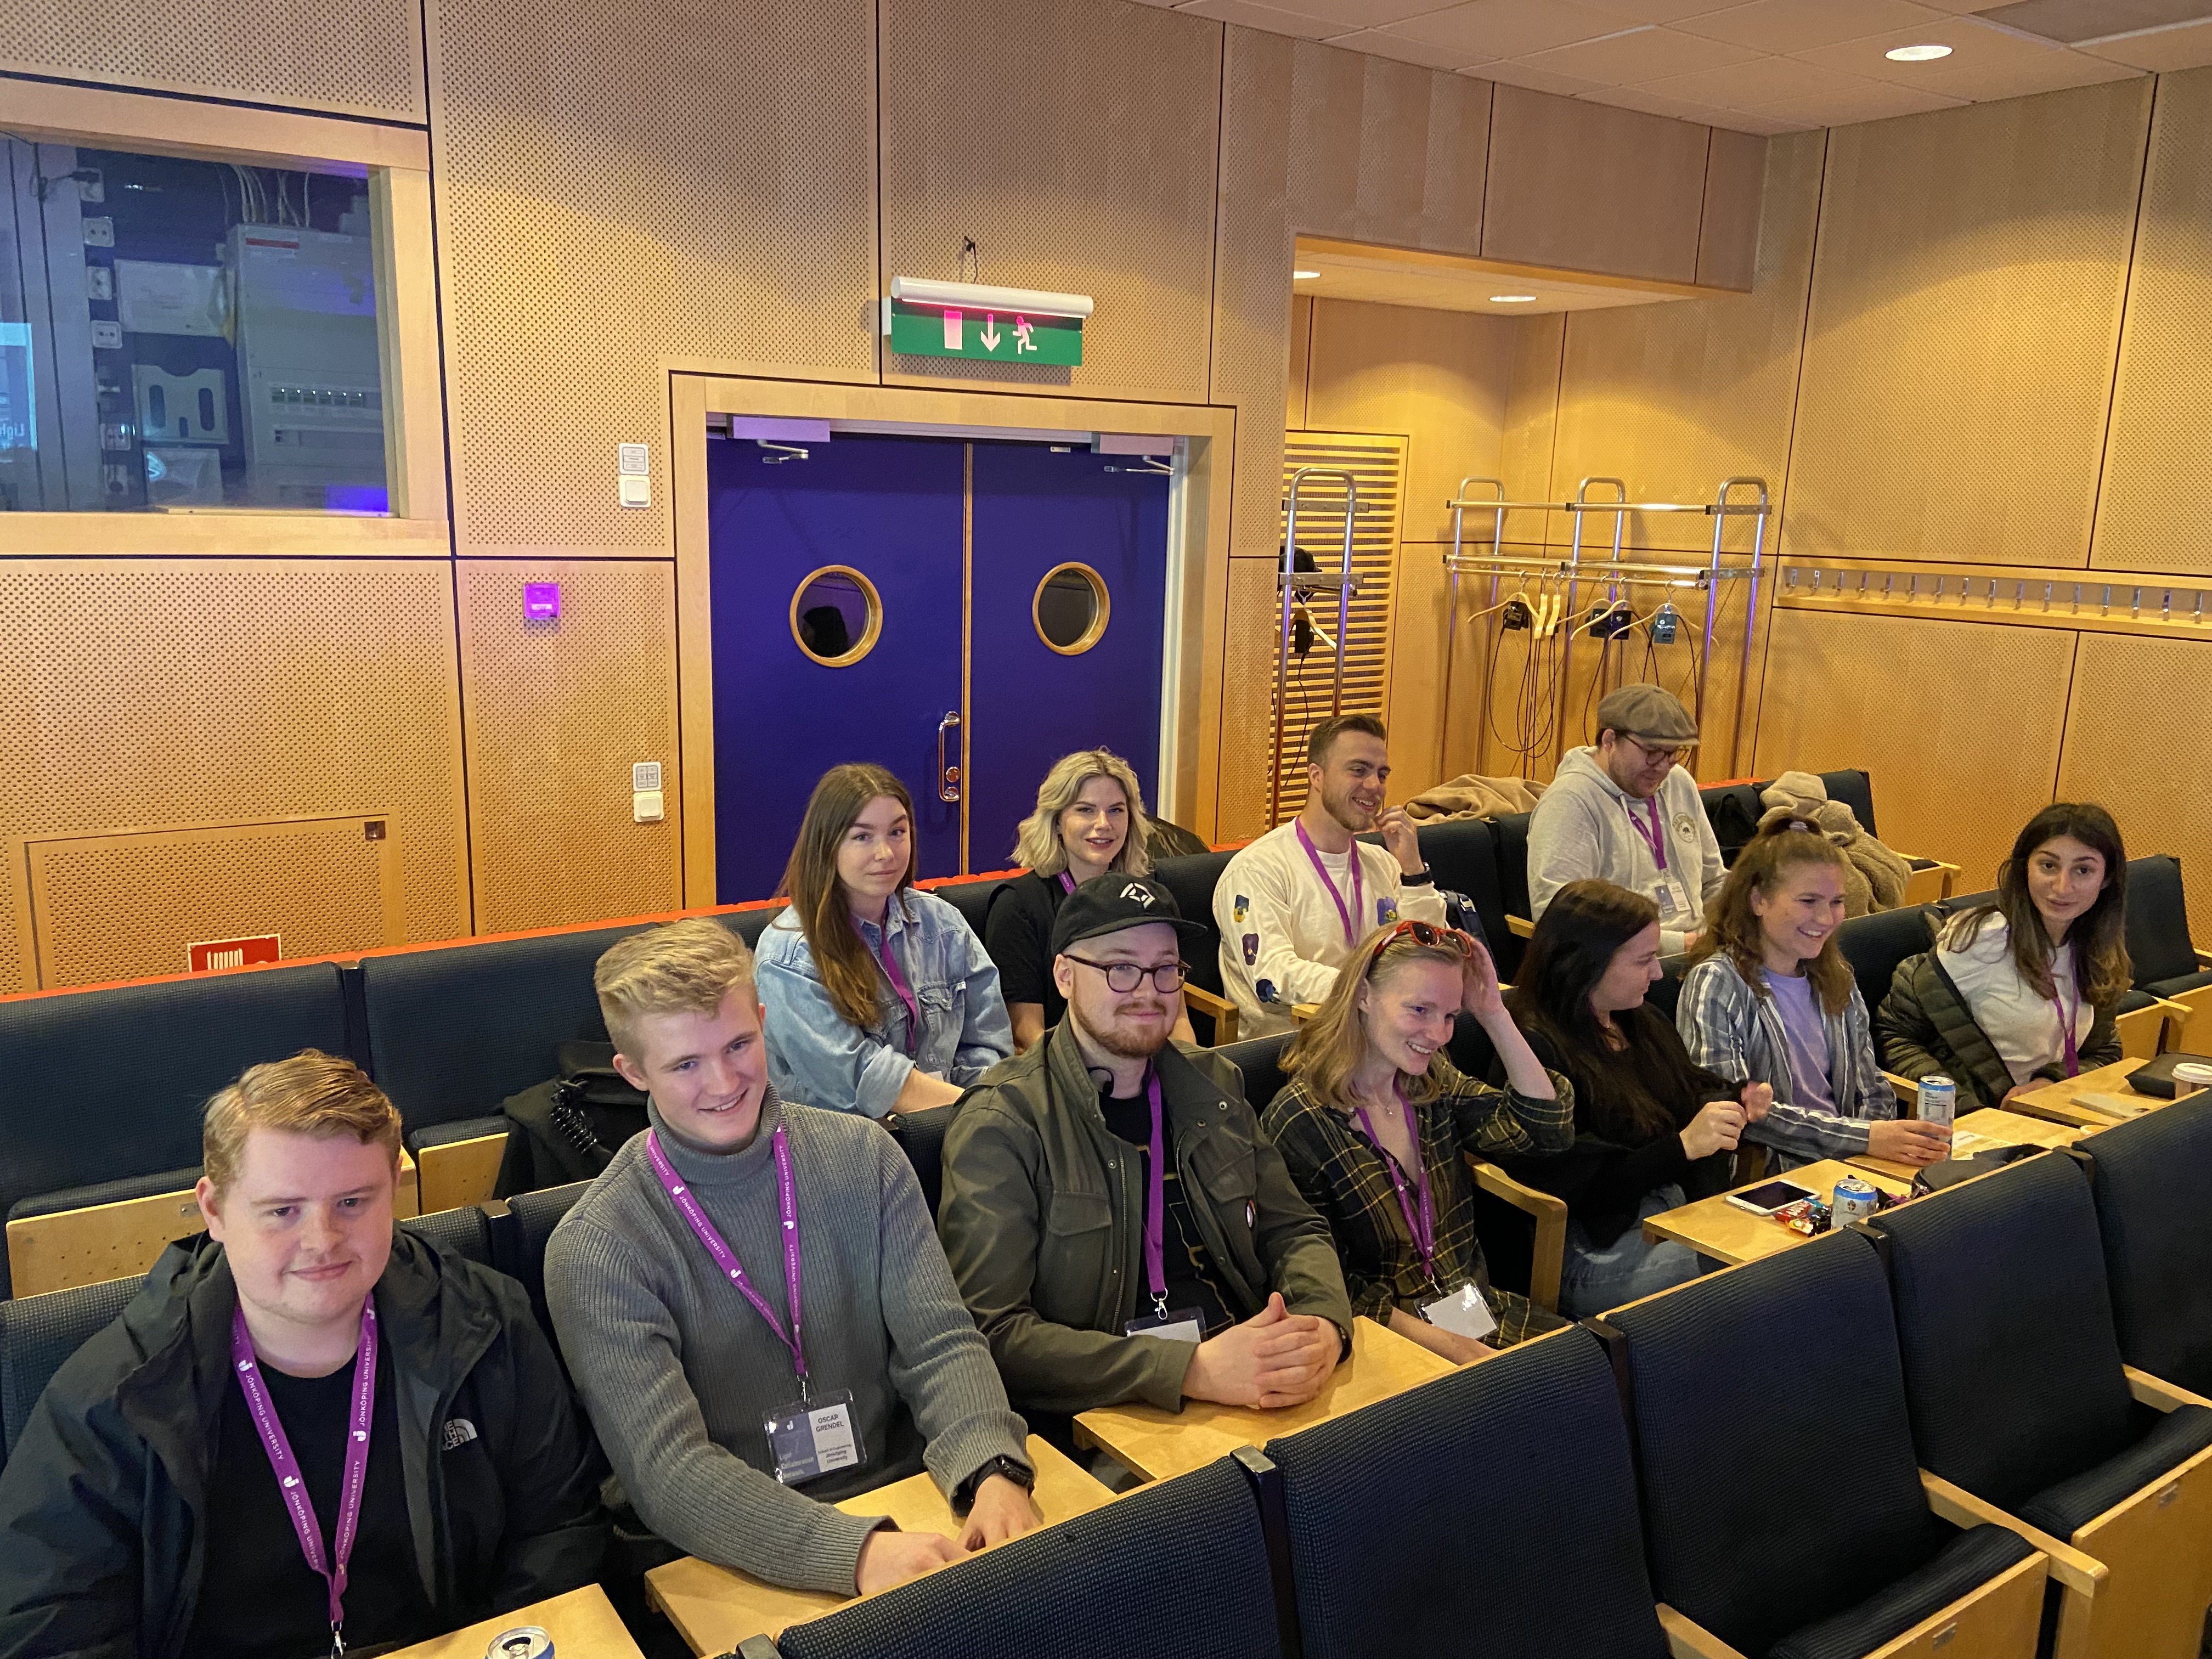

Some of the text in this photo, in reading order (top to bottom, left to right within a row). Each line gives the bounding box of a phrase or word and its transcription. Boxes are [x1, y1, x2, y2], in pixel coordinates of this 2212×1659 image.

[779, 1146, 789, 1181] UNIVERSITY
[679, 1195, 726, 1259] JÖNKÖPING UNIVERSITY
[245, 1374, 284, 1460] JÖNKÖPING UNIVERSITY
[359, 1382, 369, 1426] JÖNKÖPING
[818, 1414, 838, 1424] OSCAR
[816, 1421, 844, 1432] GRENDEL
[348, 1460, 360, 1509] UNIVERSITY
[290, 1491, 311, 1534] JÖNKÖPING
